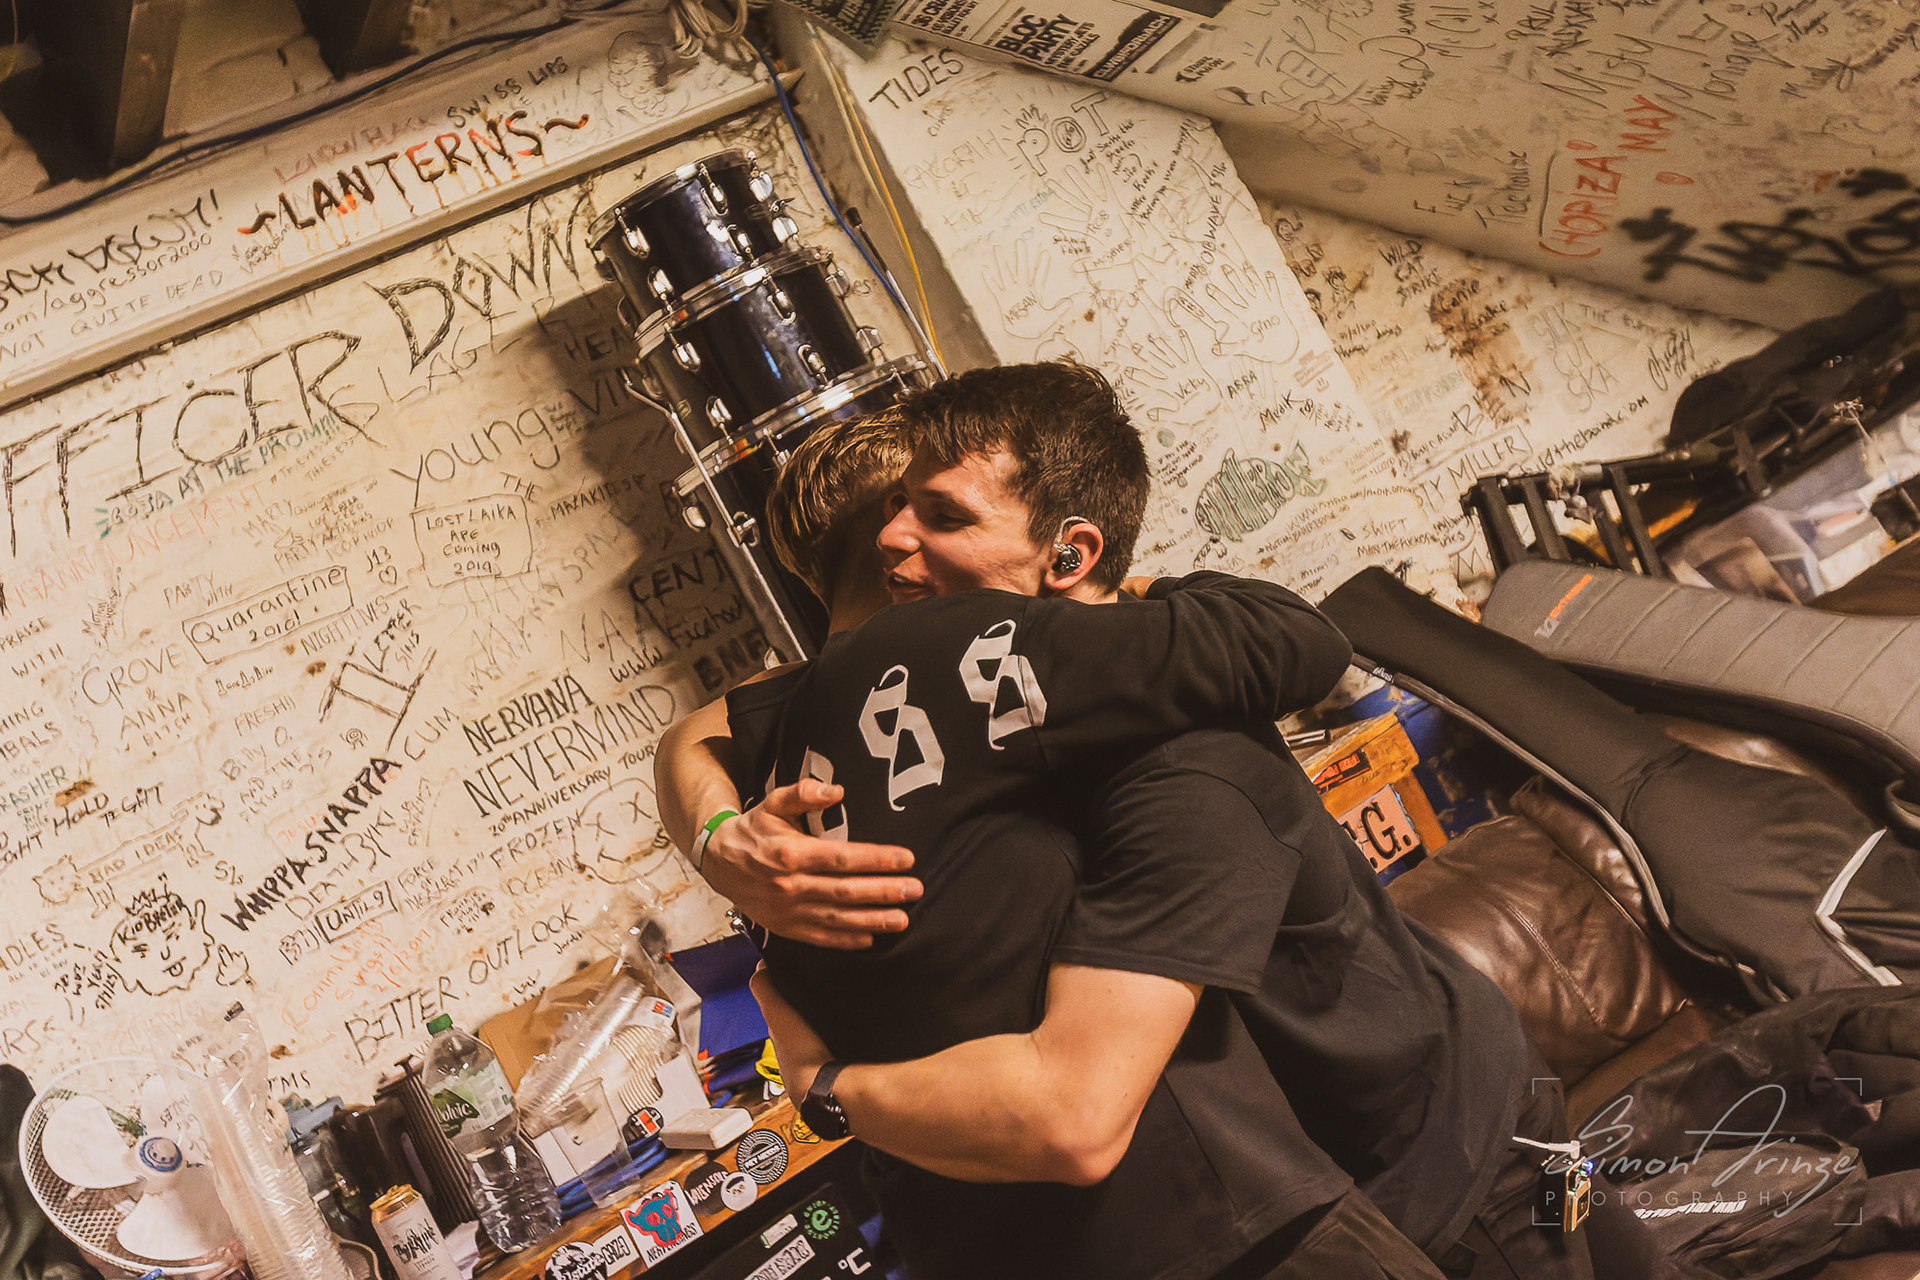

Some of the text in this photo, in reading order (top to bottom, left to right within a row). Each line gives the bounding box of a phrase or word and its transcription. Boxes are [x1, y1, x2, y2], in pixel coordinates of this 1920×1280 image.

[996, 13, 1048, 53] BLOC
[1019, 13, 1080, 61] PARTY
[447, 78, 522, 129] SWISS
[869, 47, 965, 109] TIDES
[1617, 94, 1678, 153] MAY
[278, 110, 543, 230] LANTERNS
[1378, 240, 1422, 266] WILD
[71, 294, 151, 336] QUITE
[166, 270, 223, 299] DEAD
[212, 449, 253, 482] THE
[500, 472, 543, 502] THE
[426, 503, 517, 530] LOST LAIKA
[453, 560, 493, 576] 2019
[190, 567, 345, 647] Quarantine
[11, 643, 65, 679] WITH
[82, 643, 188, 709] GROVE
[121, 692, 192, 740] ANNA
[403, 706, 461, 763] CUM
[461, 673, 594, 757] NERVANA
[462, 683, 678, 818] NEVERMIND
[618, 744, 655, 769] TOUR
[490, 808, 582, 869] FROZEN
[468, 899, 582, 986] OUTLOOK
